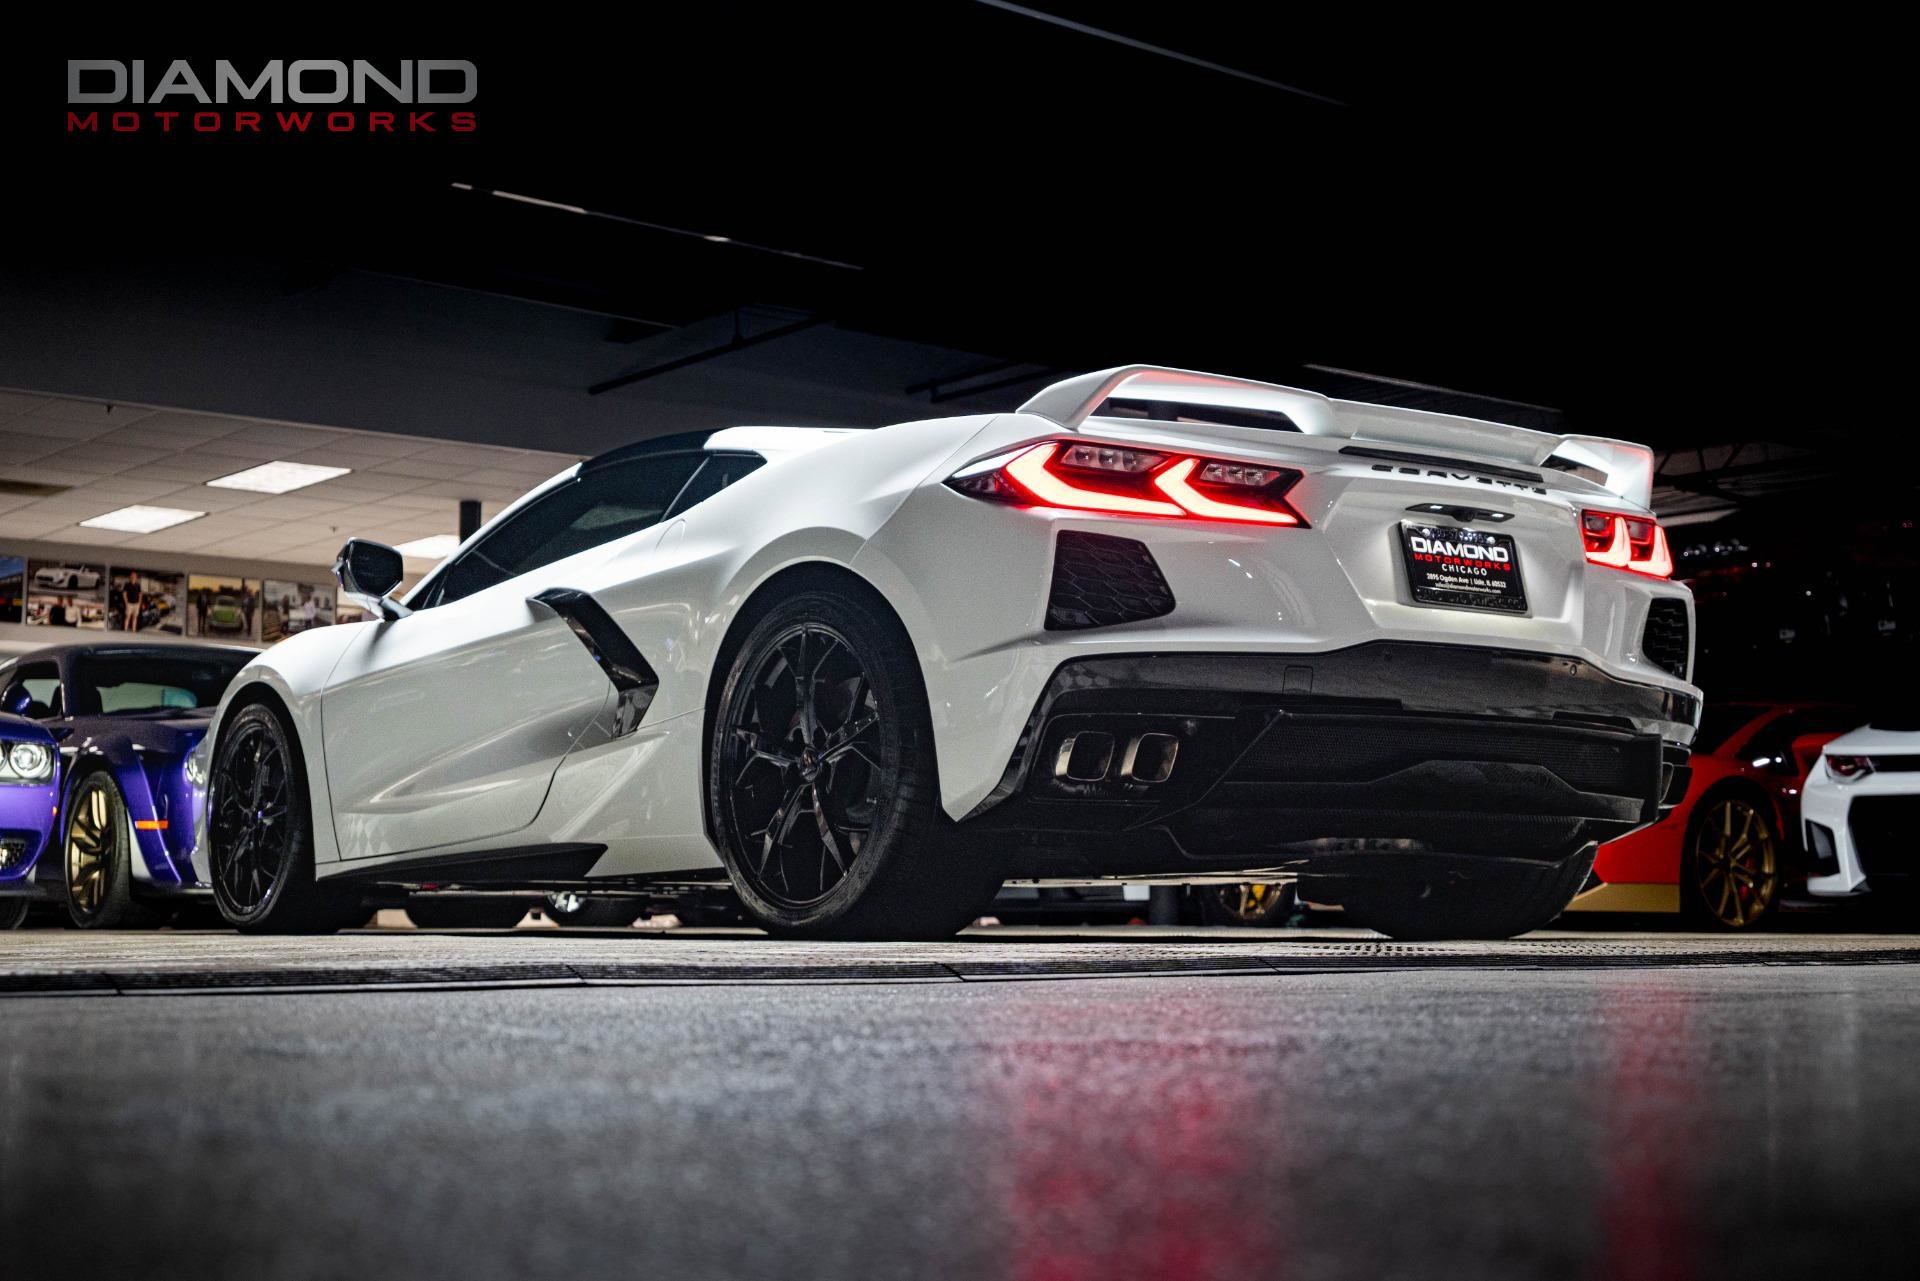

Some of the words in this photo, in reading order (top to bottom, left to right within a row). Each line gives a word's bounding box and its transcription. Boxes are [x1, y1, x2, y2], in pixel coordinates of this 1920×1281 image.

[1410, 536, 1509, 562] DIAMOND
[1413, 553, 1511, 572] MOTORWORKS
[1441, 563, 1488, 576] CHICAGO
[1439, 574, 1459, 583] Ogden
[1458, 575, 1470, 584] Ave
